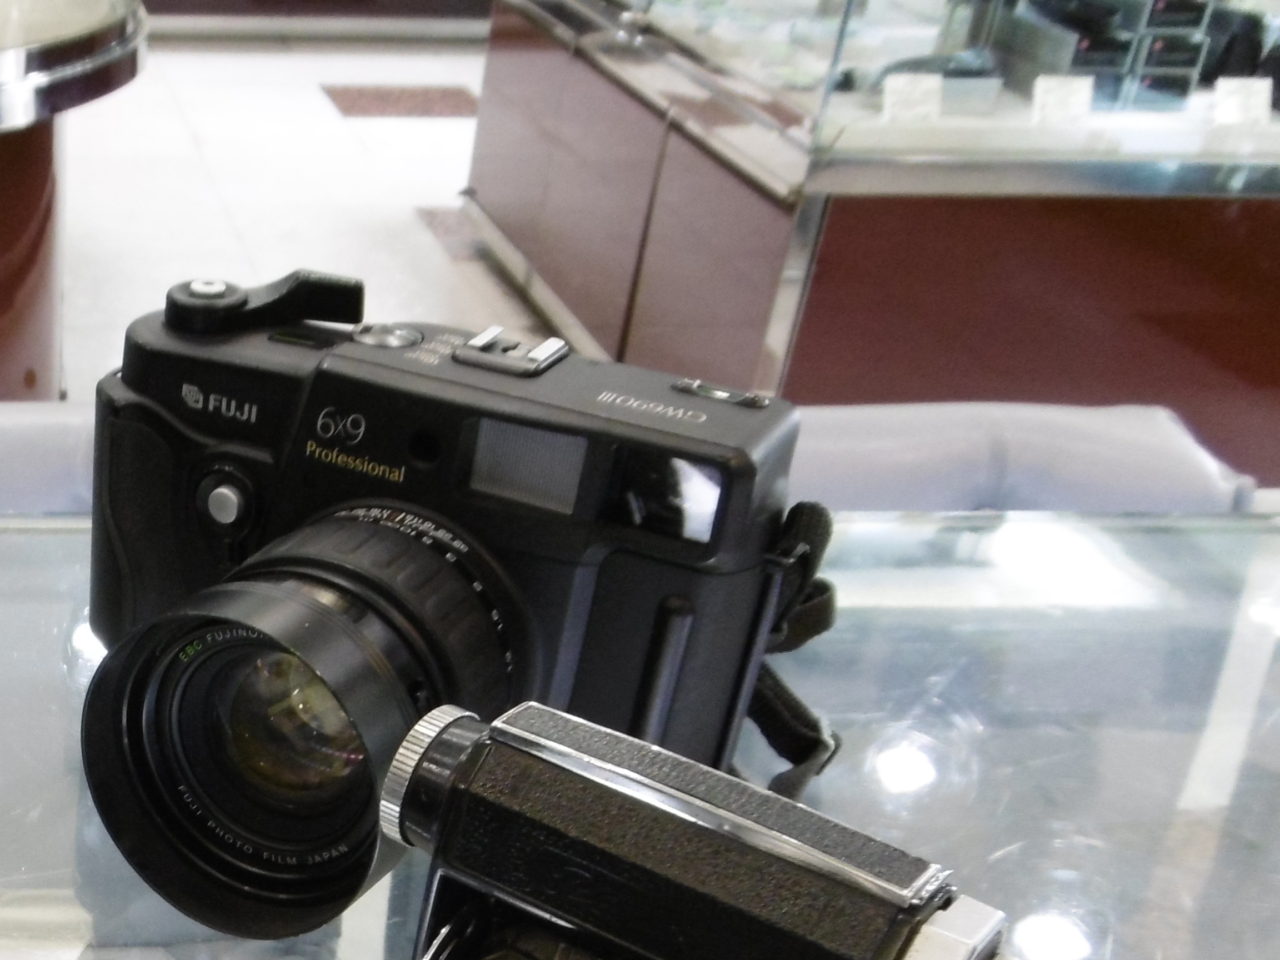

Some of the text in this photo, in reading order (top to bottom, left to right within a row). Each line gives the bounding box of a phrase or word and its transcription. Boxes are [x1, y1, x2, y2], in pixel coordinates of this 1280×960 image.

[208, 394, 258, 424] FUJI
[317, 406, 367, 446] 6x9
[306, 439, 406, 483] Professional
[179, 639, 204, 663] EBC
[178, 784, 350, 865] FUJI PHOTO FILM JAPAN
